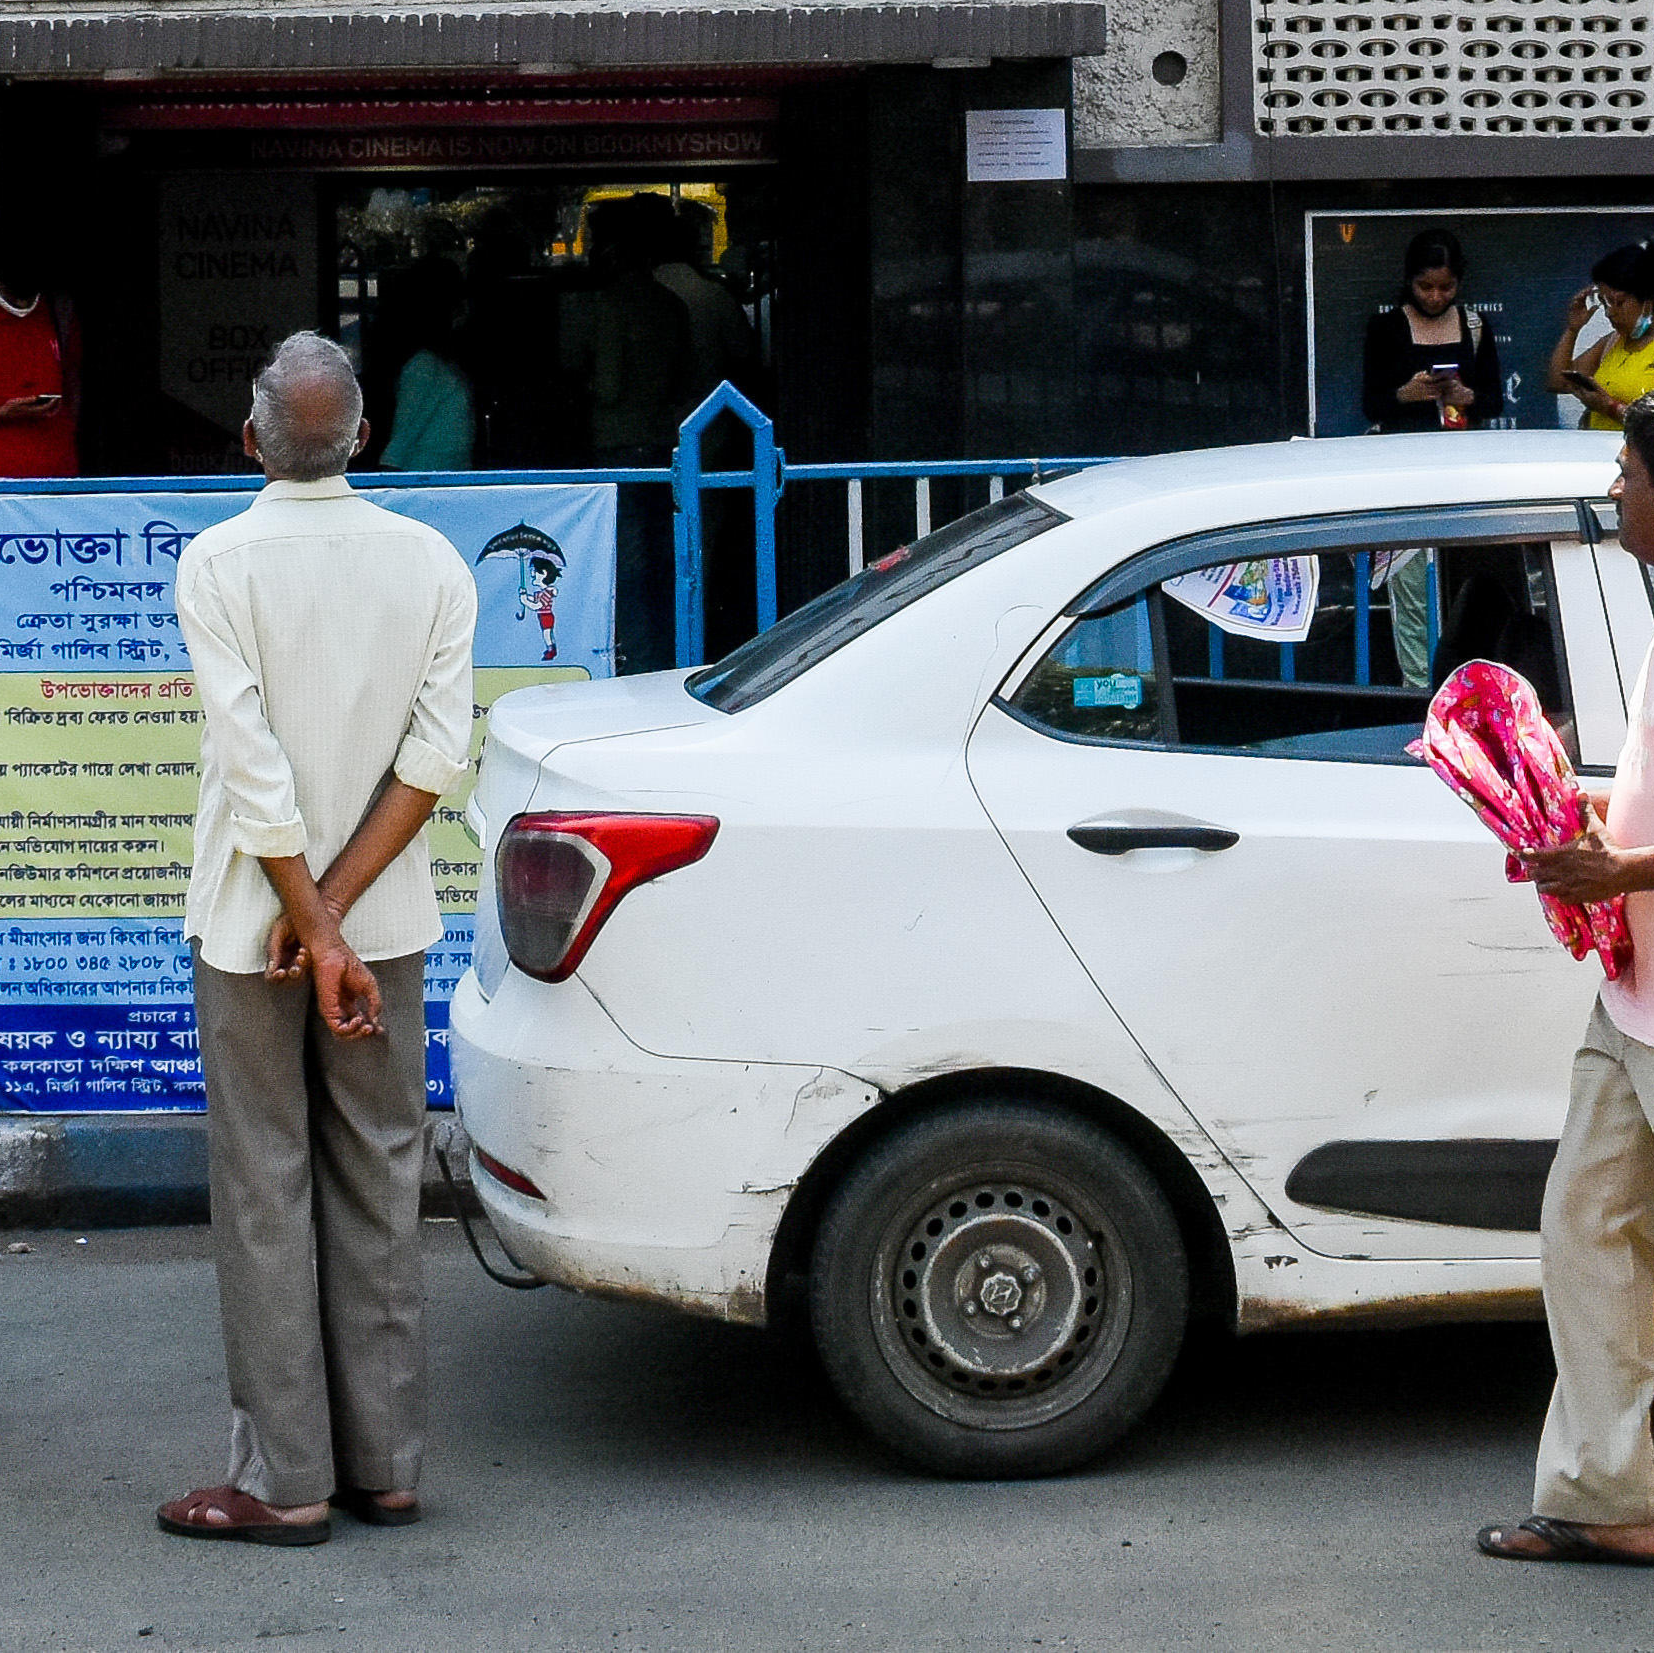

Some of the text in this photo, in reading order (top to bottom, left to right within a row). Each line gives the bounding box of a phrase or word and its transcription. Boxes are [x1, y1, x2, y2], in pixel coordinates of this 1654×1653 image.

[178, 213, 295, 241] NAVINA
[176, 253, 299, 279] CINEMA
[50, 576, 169, 602] পশ্চিমবঙ্গ
[16, 612, 141, 633] ক্রেতা সুরক্ষা
[51, 641, 110, 660] গালিব
